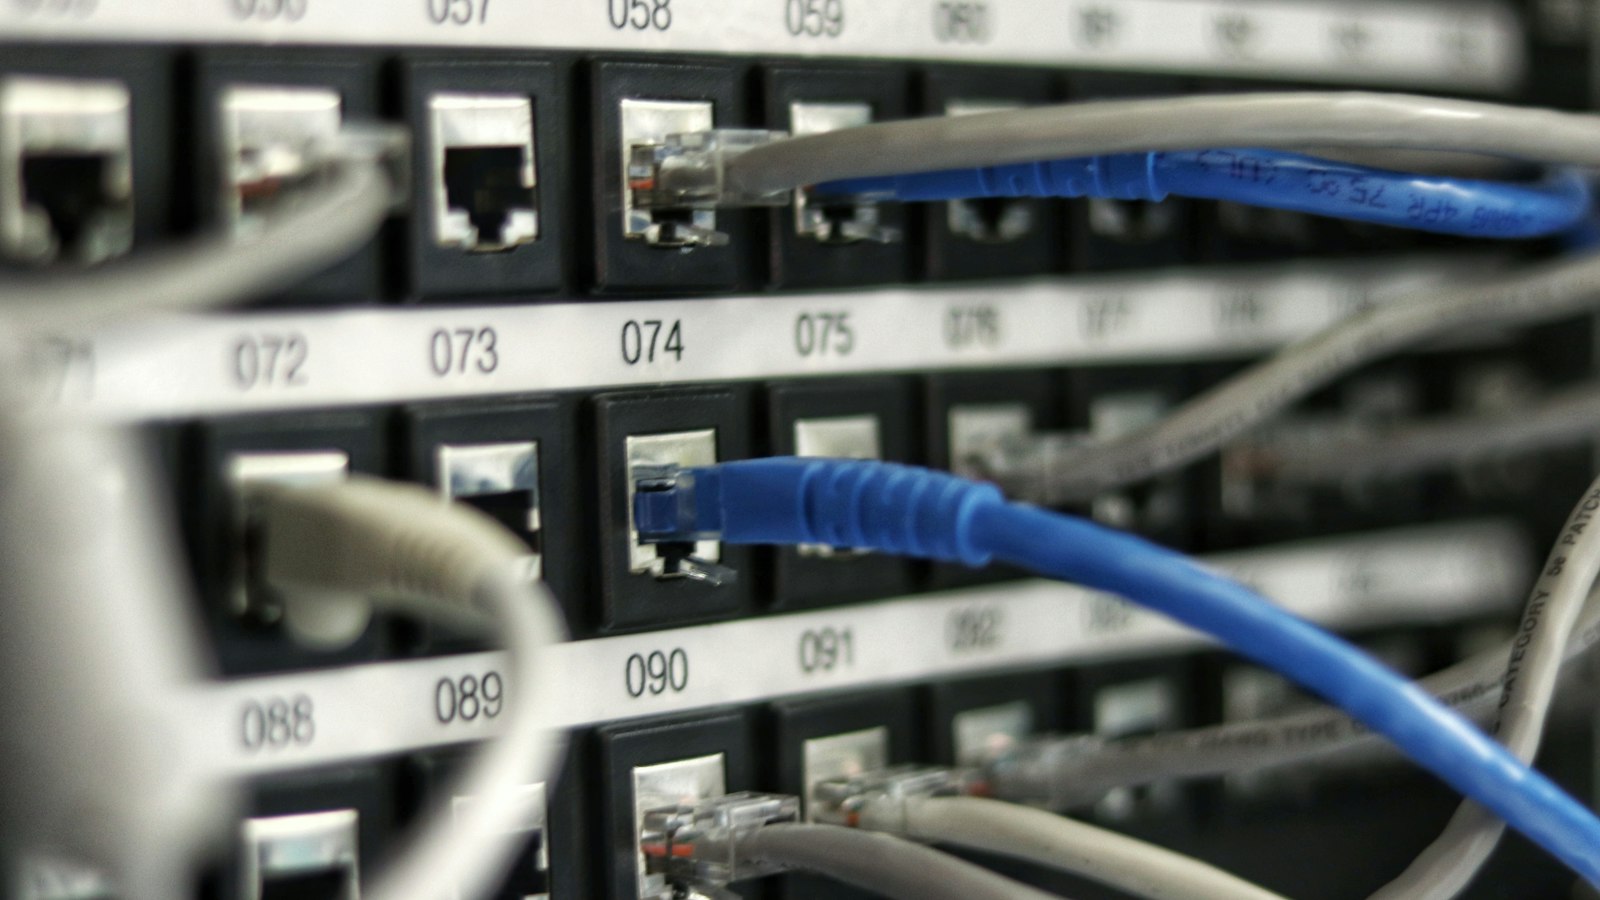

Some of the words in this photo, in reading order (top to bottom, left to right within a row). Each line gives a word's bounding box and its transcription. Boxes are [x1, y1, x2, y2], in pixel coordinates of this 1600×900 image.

[607, 0, 672, 31] 058
[783, 0, 845, 38] 059
[430, 326, 499, 376] 073
[620, 320, 685, 365] 074
[794, 311, 854, 357] 075
[231, 336, 309, 388] 072
[624, 648, 689, 698] 090
[798, 627, 855, 675] 091
[434, 671, 501, 724] 089
[239, 695, 315, 751] 088
